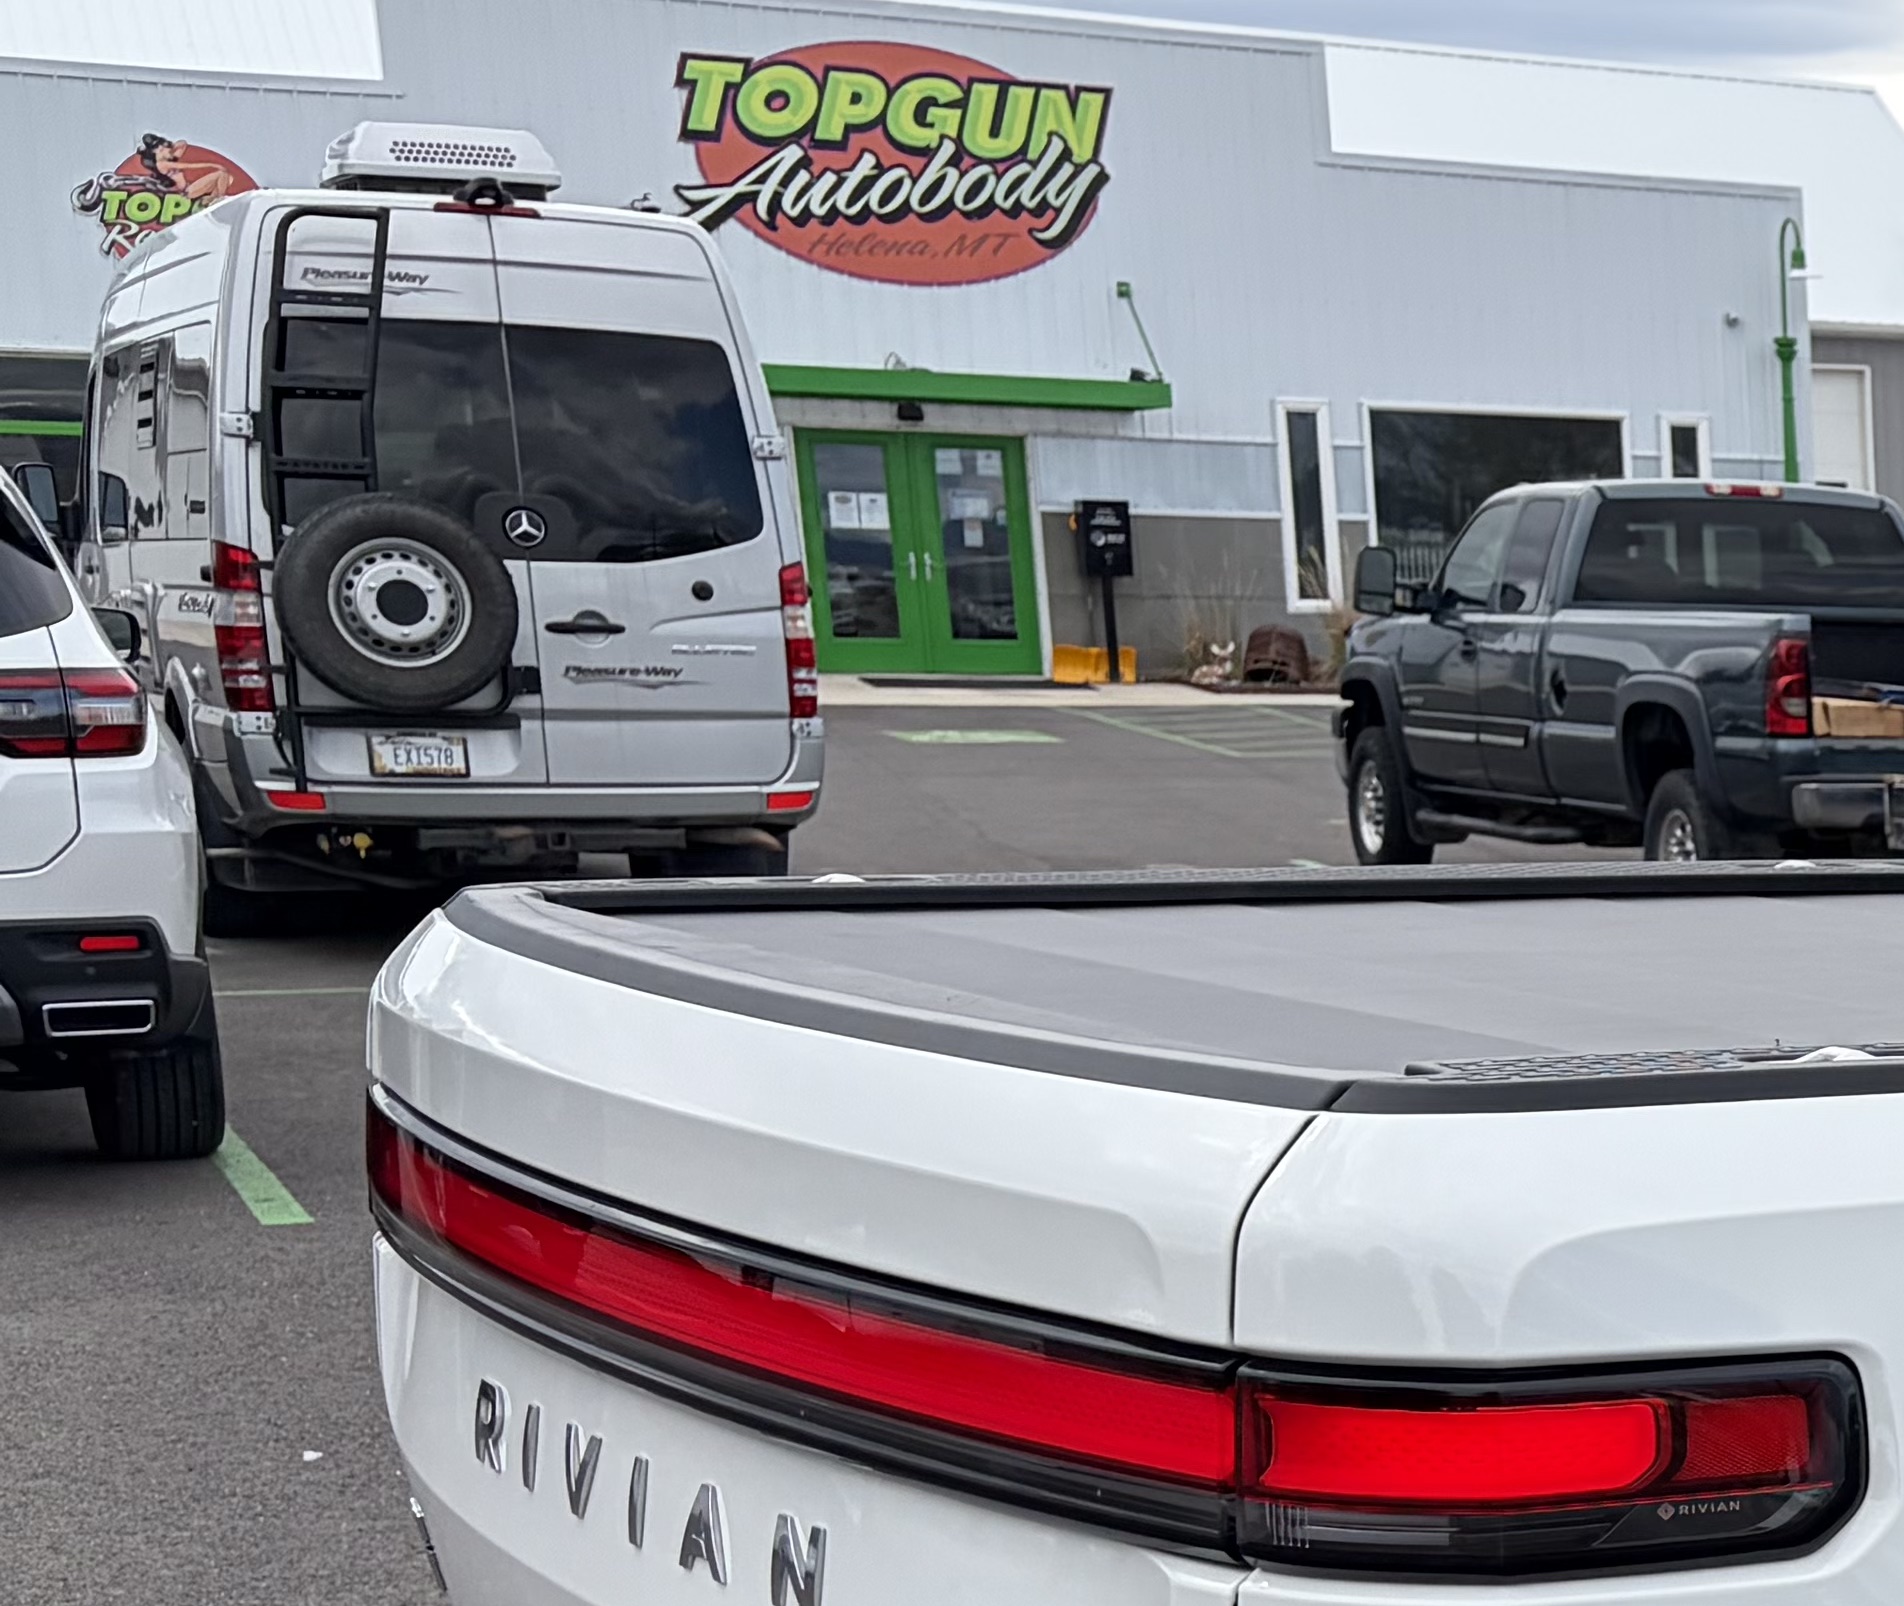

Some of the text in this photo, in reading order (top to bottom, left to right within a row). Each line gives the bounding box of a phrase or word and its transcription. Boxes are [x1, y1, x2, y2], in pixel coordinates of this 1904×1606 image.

[681, 58, 1107, 163] TOPGUN
[677, 131, 1104, 244] Autobody
[943, 233, 1021, 258] MT
[1679, 1500, 1741, 1516] RIVIAN
